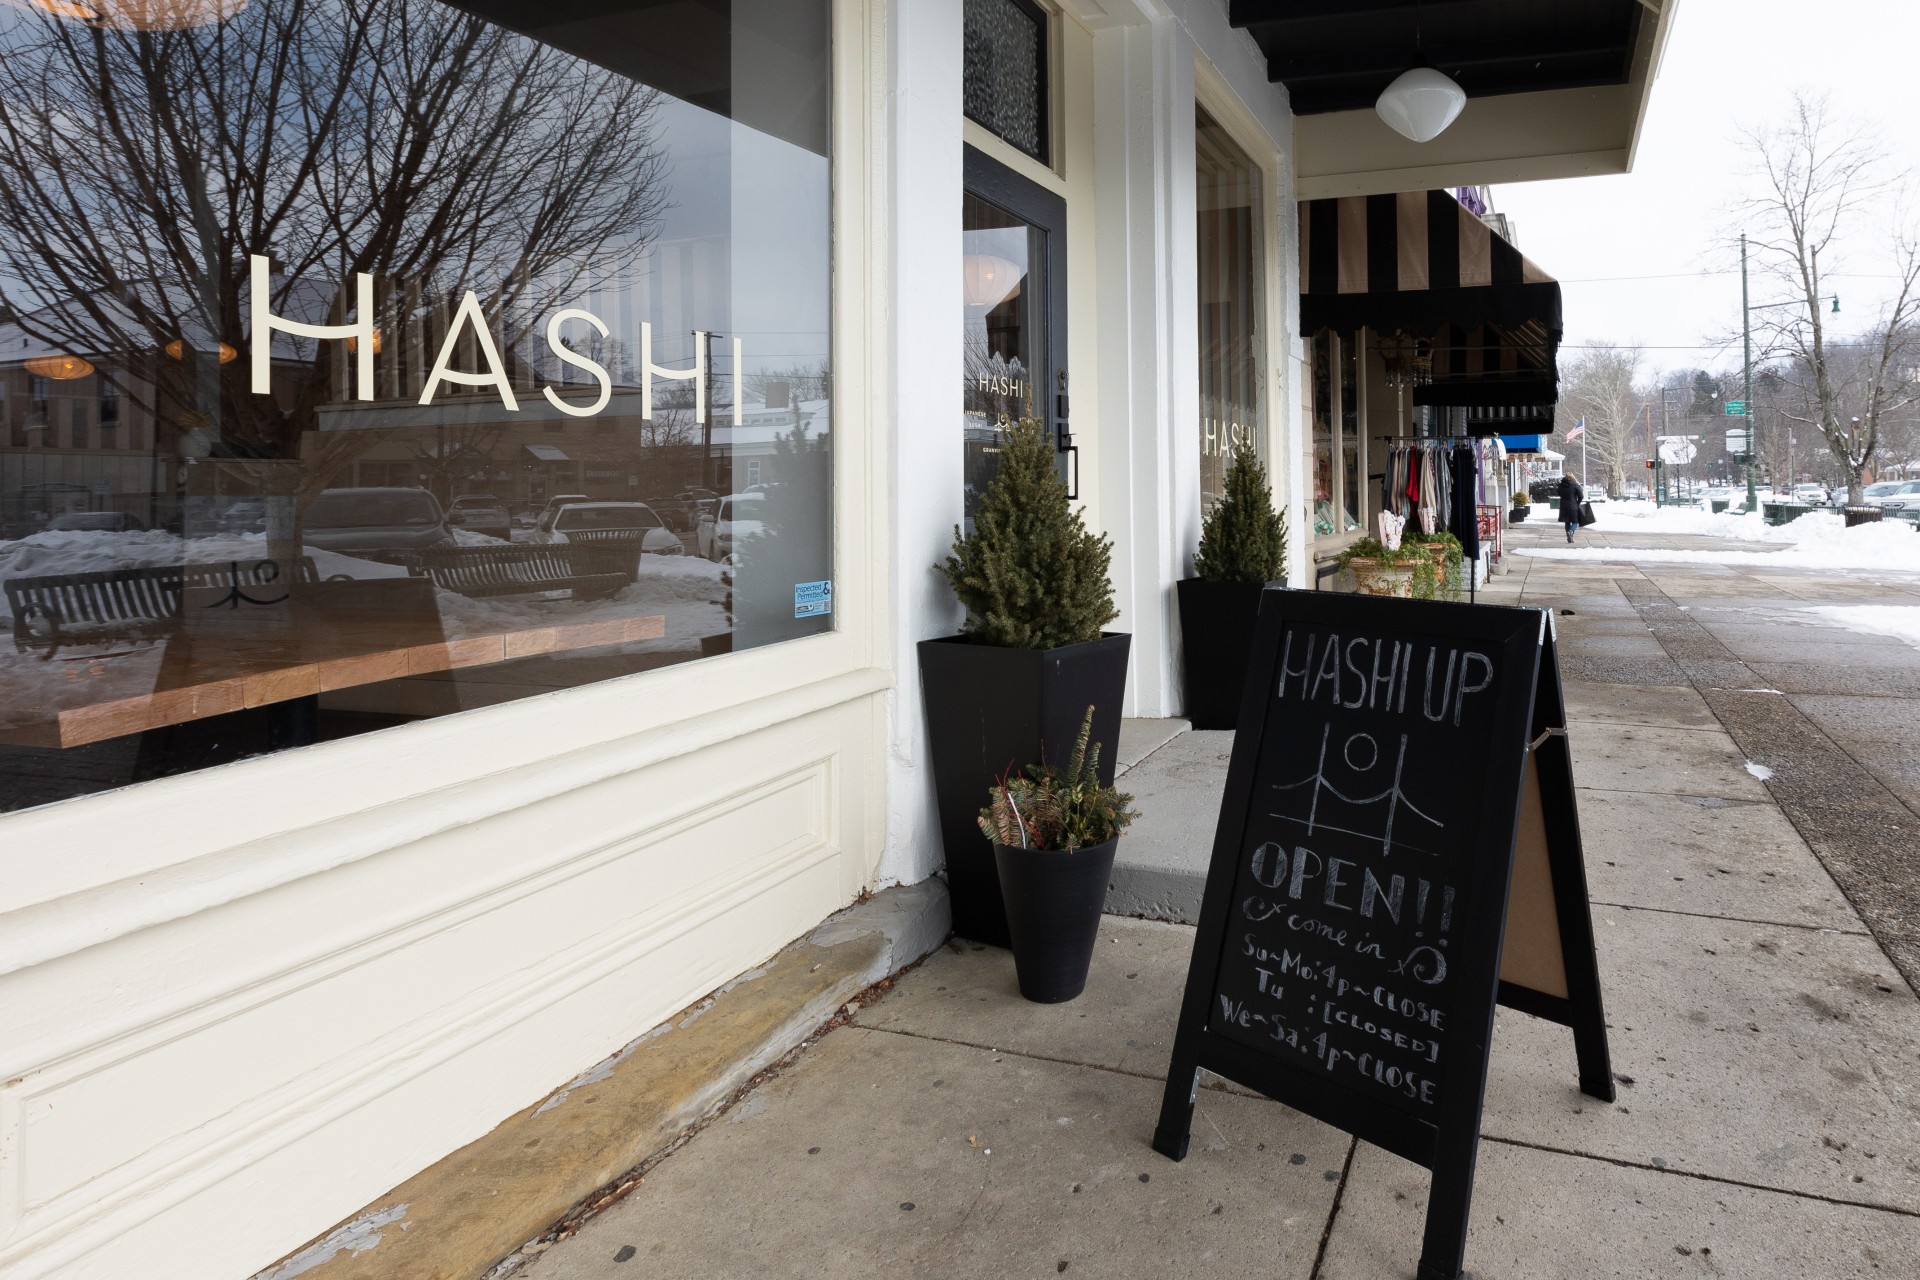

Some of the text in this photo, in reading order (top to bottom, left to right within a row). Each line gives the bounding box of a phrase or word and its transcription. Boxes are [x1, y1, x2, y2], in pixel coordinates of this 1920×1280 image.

[250, 253, 743, 427] HASHI
[979, 371, 1023, 398] HASHI
[1205, 417, 1256, 459] HASHI
[796, 584, 821, 593] Inspected
[797, 592, 823, 600] Permitted
[1278, 630, 1494, 727] HASHI UP
[1287, 914, 1386, 959] come in
[1255, 967, 1284, 1000] Tu
